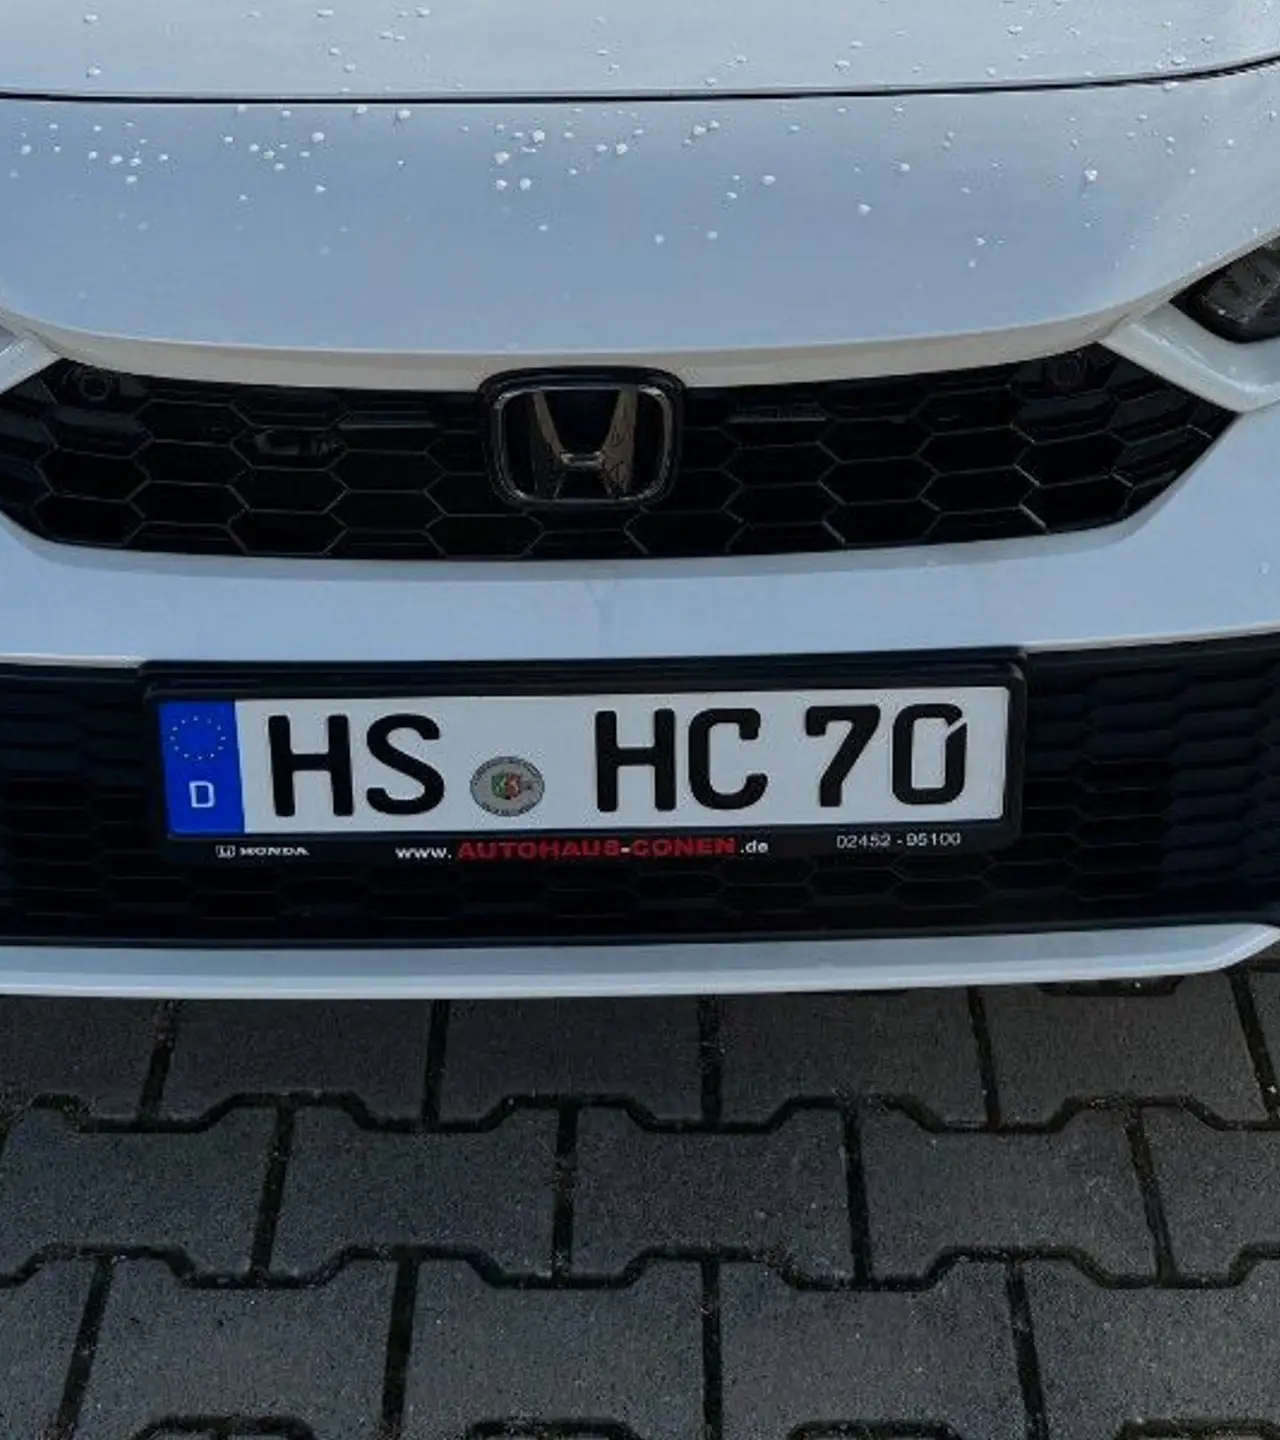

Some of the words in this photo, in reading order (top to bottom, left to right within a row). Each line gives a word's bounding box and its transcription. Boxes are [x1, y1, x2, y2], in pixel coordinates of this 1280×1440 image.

[267, 713, 446, 817] HS
[594, 707, 769, 813] HC
[805, 702, 968, 808] 70
[189, 781, 216, 809] D
[240, 846, 311, 857] HONDA
[836, 833, 892, 849] 02452
[906, 831, 962, 847] 95100
